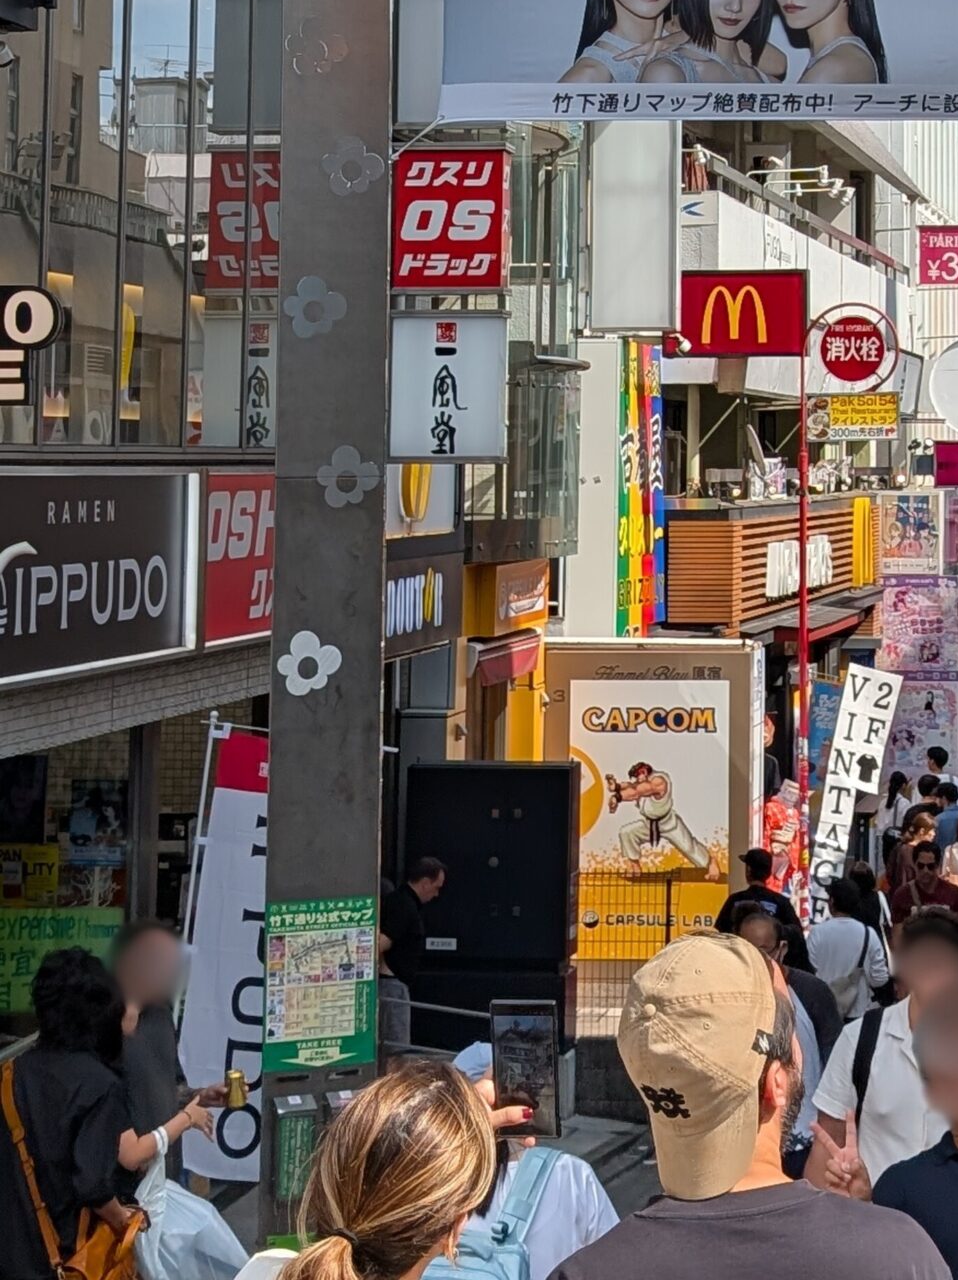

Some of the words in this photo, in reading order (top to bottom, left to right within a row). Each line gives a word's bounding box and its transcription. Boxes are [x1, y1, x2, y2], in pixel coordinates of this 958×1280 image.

[552, 93, 834, 113] 竹下通りマップ絶賛配布中!
[404, 161, 494, 187] クスリ
[400, 200, 495, 241] OS
[398, 253, 497, 276] ドラッグ
[825, 336, 882, 362] 消火栓
[831, 416, 897, 426] タイレストラン
[47, 500, 116, 524] RAMEN
[13, 554, 168, 637] IPPUDO
[582, 707, 717, 733] CAPCOM
[269, 907, 374, 928] 竹下通り公式マップ
[605, 915, 676, 928] CAPSULE
[682, 915, 713, 928] LAB
